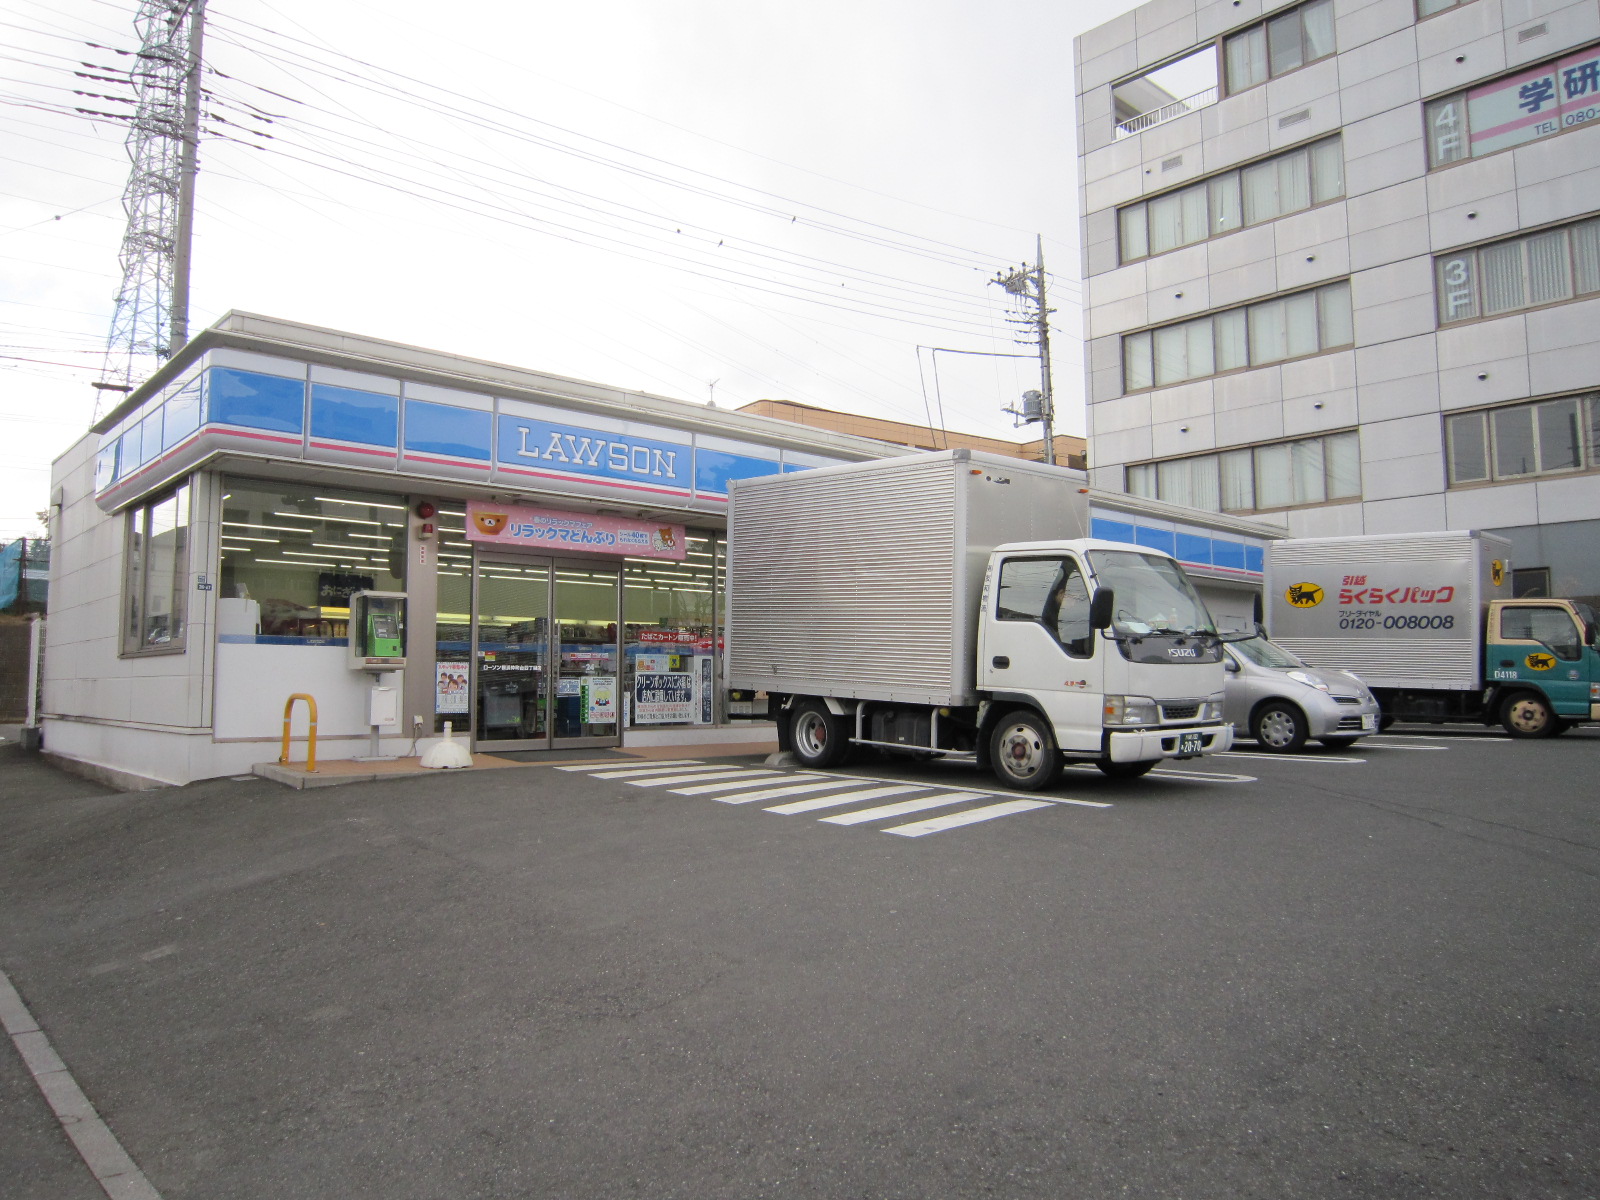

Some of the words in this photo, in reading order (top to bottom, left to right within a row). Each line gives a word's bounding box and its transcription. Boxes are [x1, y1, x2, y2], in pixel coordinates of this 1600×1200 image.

[1519, 60, 1600, 114] 学研
[1535, 121, 1557, 135] TEL
[517, 426, 677, 479] LAWSON
[510, 523, 616, 546] リラックマどんぶり
[1342, 575, 1367, 586] 引越
[1339, 586, 1455, 604] らくらくパック
[1339, 615, 1455, 629] 0120-008008
[1167, 648, 1196, 657] ISUZU
[1494, 671, 1518, 679] D4118
